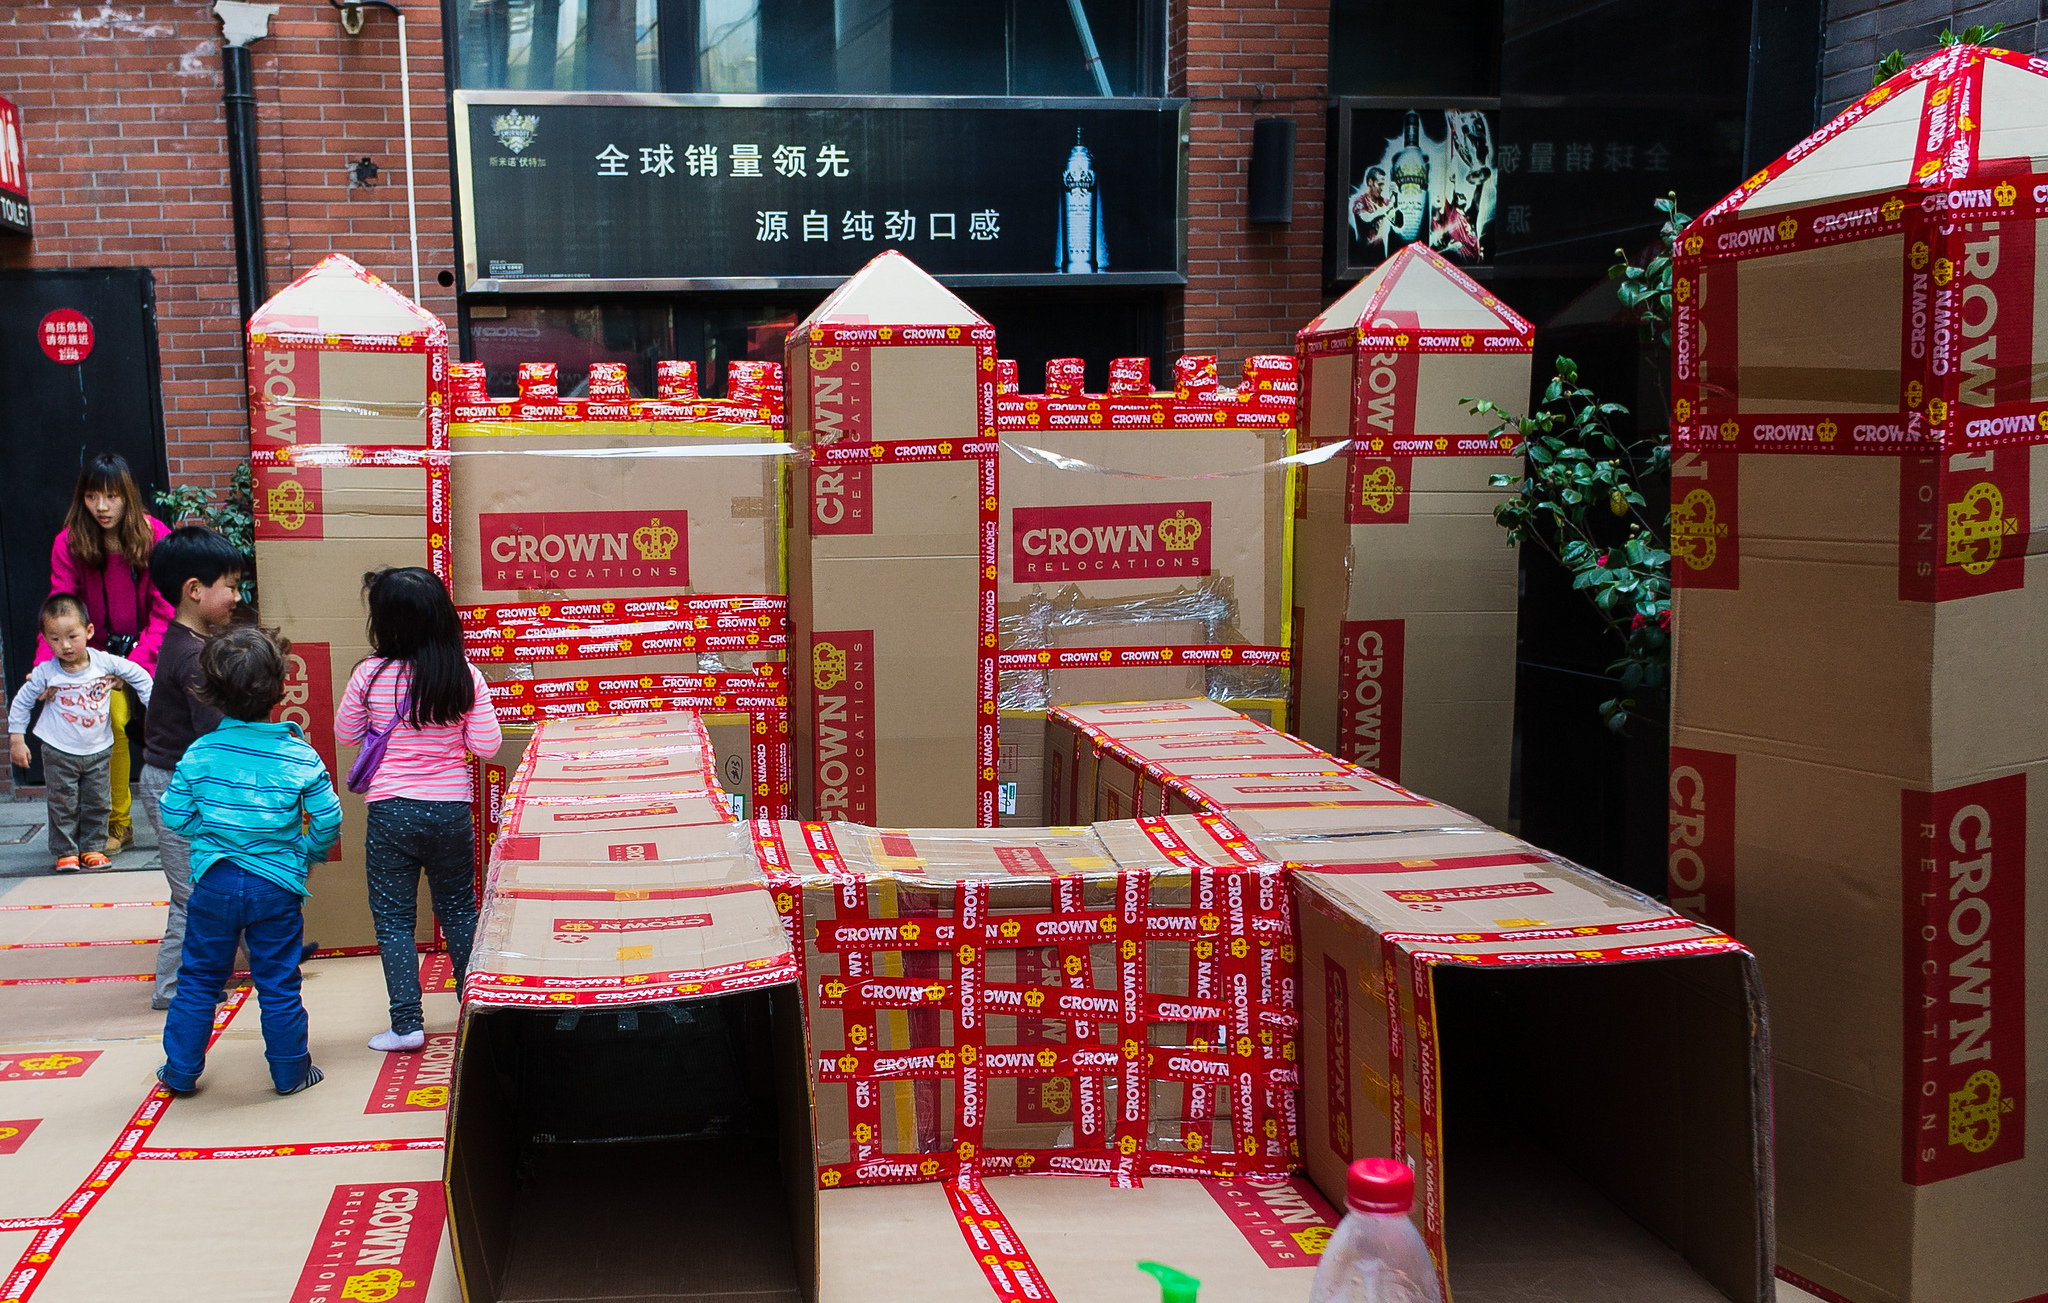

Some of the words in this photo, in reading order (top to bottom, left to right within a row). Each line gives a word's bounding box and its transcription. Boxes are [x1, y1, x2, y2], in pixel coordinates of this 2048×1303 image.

[1786, 105, 1864, 161] CROWN
[1927, 104, 1948, 152] CROWN
[595, 143, 851, 179] 全球销量领先
[1, 196, 29, 226] TOILET
[756, 209, 1001, 242] 源自纯劲口感
[1718, 226, 1775, 249] CROWN
[1813, 208, 1879, 234] CROWN
[1920, 189, 1991, 213] CROWN
[1719, 242, 1796, 259] RELOCATIONS
[1815, 223, 1901, 243] RELOCATIONS
[1923, 210, 2015, 223] RELOCATIONS
[1911, 273, 1928, 358] CROWN
[1952, 260, 1960, 372] RELOCATIONS
[278, 334, 324, 345] CROWN
[352, 336, 397, 346] CROWN
[834, 330, 877, 340] CROWN
[903, 329, 945, 340] CROWN
[1418, 336, 1460, 347] CROWN
[1678, 306, 1690, 380] CROWN
[1932, 290, 1952, 376] CROWN
[455, 407, 496, 417] CROWN
[522, 406, 563, 416] CROWN
[588, 405, 628, 416] CROWN
[653, 405, 693, 416] CROWN
[718, 407, 757, 418] CROWN
[984, 382, 993, 426] CROWN
[1050, 415, 1090, 425] CROWN
[1112, 415, 1150, 424] CROWN
[1174, 414, 1213, 424] CROWN
[1236, 414, 1275, 424] CROWN
[1753, 425, 1814, 441] CROWN
[1966, 415, 2036, 438] CROWN
[826, 449, 870, 460] CROWN
[894, 445, 937, 456] CROWN
[1393, 440, 1433, 451] CROWN
[432, 479, 442, 523] CROWN
[491, 533, 628, 563] CROWN
[986, 521, 995, 564] CROWN
[1022, 525, 1154, 556] CROWN
[497, 566, 678, 580] RELOCATIONS
[1028, 558, 1200, 572] RELOCATIONS
[496, 607, 537, 619] CROWN
[561, 604, 601, 615] CROWN
[625, 601, 665, 612] CROWN
[689, 600, 729, 610] CROWN
[717, 617, 757, 628] CROWN
[985, 590, 995, 633] CROWN
[514, 646, 554, 657] CROWN
[578, 642, 619, 653] CROWN
[642, 638, 682, 649] CROWN
[706, 636, 746, 646] CROWN
[999, 654, 1036, 664] CROWN
[1060, 652, 1098, 662] CROWN
[1121, 650, 1159, 660] CROWN
[1182, 649, 1220, 660] CROWN
[1242, 650, 1280, 660] CROWN
[534, 682, 574, 693] CROWN
[599, 679, 638, 690] CROWN
[663, 678, 702, 688] CROWN
[984, 658, 994, 699] CROWN
[545, 703, 585, 714] CROWN
[609, 700, 649, 710] CROWN
[673, 696, 712, 707] CROWN
[736, 696, 775, 706] CROWN
[1355, 631, 1383, 769] CROWN
[983, 725, 993, 766] CROWN
[757, 744, 766, 782] CROWN
[491, 784, 499, 823] CROWN
[560, 810, 641, 819] CROWN
[807, 830, 828, 851] CROWN
[1228, 874, 1244, 936] CROWN
[1435, 887, 1538, 900] CROWN
[600, 916, 704, 930] CROWN
[835, 927, 897, 941] CROWN
[1036, 920, 1098, 935] CROWN
[1220, 877, 1229, 957] RELOCATIONS
[1385, 933, 1455, 942] CROWN
[1499, 929, 1573, 940] CROWN
[1616, 918, 1690, 931] CROWN
[1498, 952, 1575, 962] CROWN
[1621, 940, 1700, 956] CROWN
[1948, 804, 1993, 1066] CROWN
[468, 989, 546, 1001] CROWN
[595, 987, 675, 1000] CROWN
[721, 967, 797, 988] CROWN
[668, 965, 743, 980] CROWN
[861, 985, 922, 1001] CROWN
[1060, 996, 1118, 1011] CROWN
[1158, 1003, 1220, 1017] CROWN
[960, 967, 975, 1029] CROWN
[1124, 962, 1136, 1024] CROWN
[1234, 973, 1248, 1034] CROWN
[1920, 823, 1938, 1162] RELOCATIONS
[1226, 976, 1235, 1056] RELOCATIONS
[1391, 986, 1401, 1058] CROWN
[1334, 971, 1345, 1106] CROWN
[874, 1055, 934, 1072] CROWN
[1168, 1057, 1229, 1076] CROWN
[1421, 1041, 1430, 1116] CROWN
[963, 1067, 977, 1127] CROWN
[1080, 1076, 1095, 1135] CROWN
[1126, 1061, 1139, 1121] CROWN
[1240, 1072, 1253, 1133] CROWN
[141, 1100, 163, 1119] CROWN
[1233, 1075, 1242, 1154] RELOCATIONS
[120, 1129, 144, 1150] CROWN
[212, 1149, 274, 1158] CROWN
[309, 1144, 371, 1153] CROWN
[99, 1160, 121, 1180] CROWN
[856, 1164, 918, 1179] CROWN
[1050, 1157, 1111, 1171] CROWN
[1150, 1164, 1211, 1176] CROWN
[67, 1191, 96, 1213] CROWN
[0, 1219, 63, 1228] CROWN
[355, 1187, 419, 1266] CROWN
[1218, 1180, 1295, 1259] OCATIONS
[309, 1191, 365, 1303] RELOCATIONS
[989, 1229, 1016, 1255] CROWN
[5, 1268, 37, 1299] CROWN
[1013, 1270, 1041, 1299] CROWN
